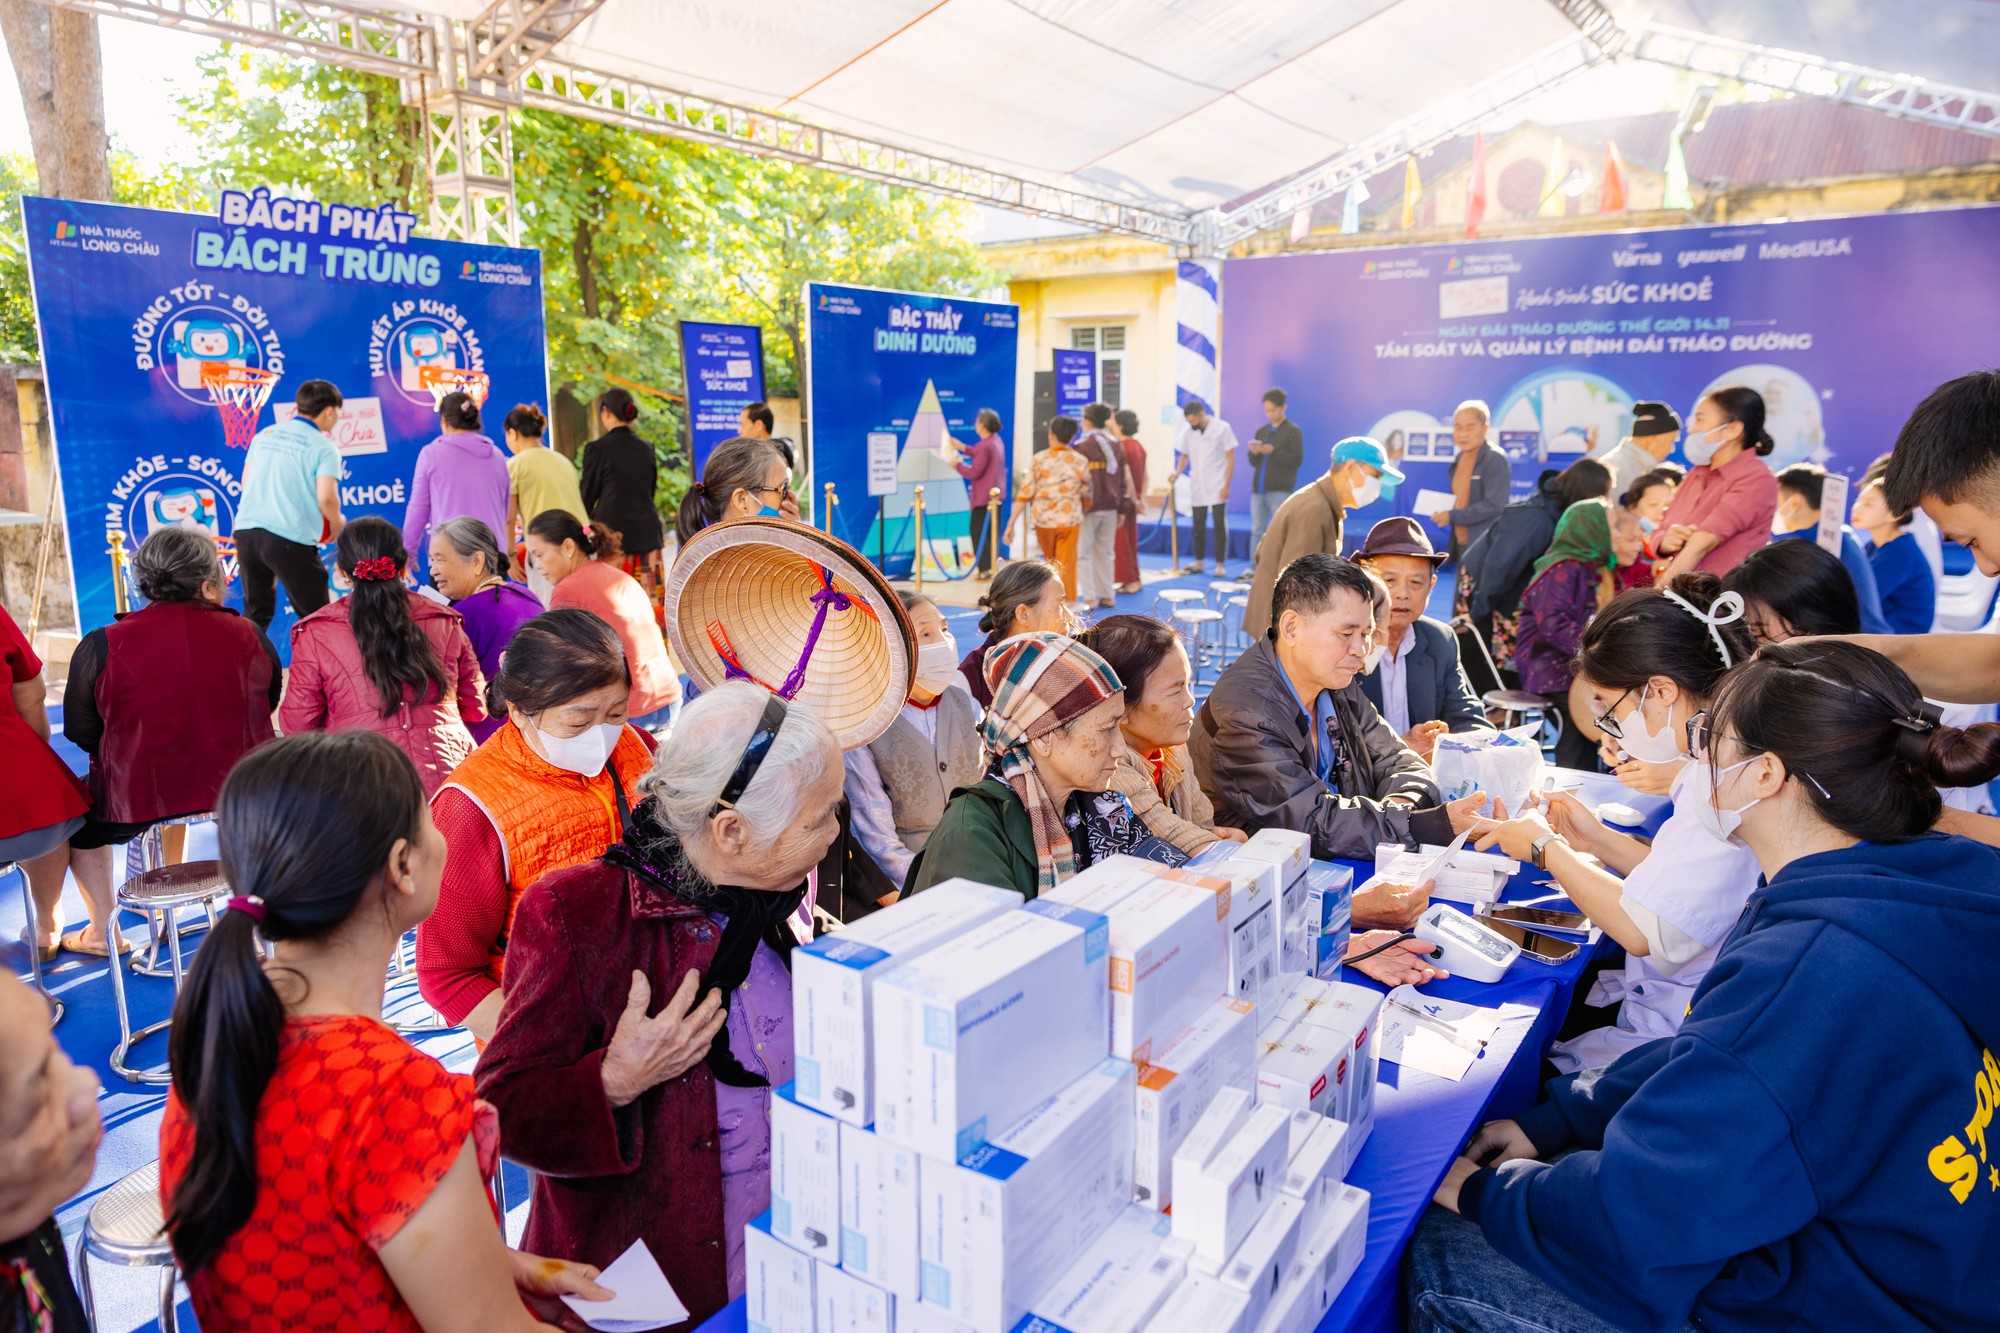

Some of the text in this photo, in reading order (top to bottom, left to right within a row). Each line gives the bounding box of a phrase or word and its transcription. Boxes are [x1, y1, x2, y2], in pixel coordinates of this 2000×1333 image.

[223, 189, 415, 244] BÁCH PHÁT
[79, 224, 142, 240] NHÀ THUỐC
[82, 238, 160, 256] LONG CHÂU
[195, 227, 440, 286] BÁCH TRÚNG
[1590, 280, 1639, 305] SỨC
[1643, 275, 1714, 303] KHOẺ
[132, 296, 173, 371] ĐƯỜNG
[170, 279, 214, 306] TỐT
[231, 293, 269, 331] ĐỜI
[891, 303, 963, 333] BẬC THẦY
[369, 314, 393, 377] HUYẾT
[392, 300, 416, 321] ÁP
[419, 298, 468, 331] KHỎE
[876, 330, 977, 355] DINH DƯỠNG
[1412, 339, 1458, 358] SOÁT
[1460, 340, 1485, 357] VÀ
[1488, 336, 1542, 358] QUẢN
[1544, 336, 1568, 356] LÝ
[1570, 335, 1624, 358] BỆNH
[1626, 333, 1664, 354] ĐÁI
[1667, 332, 1727, 353] THÁO
[1729, 330, 1813, 352] ĐƯỜNG
[112, 454, 169, 501] KHỎE
[341, 477, 405, 506] KHOẺ
